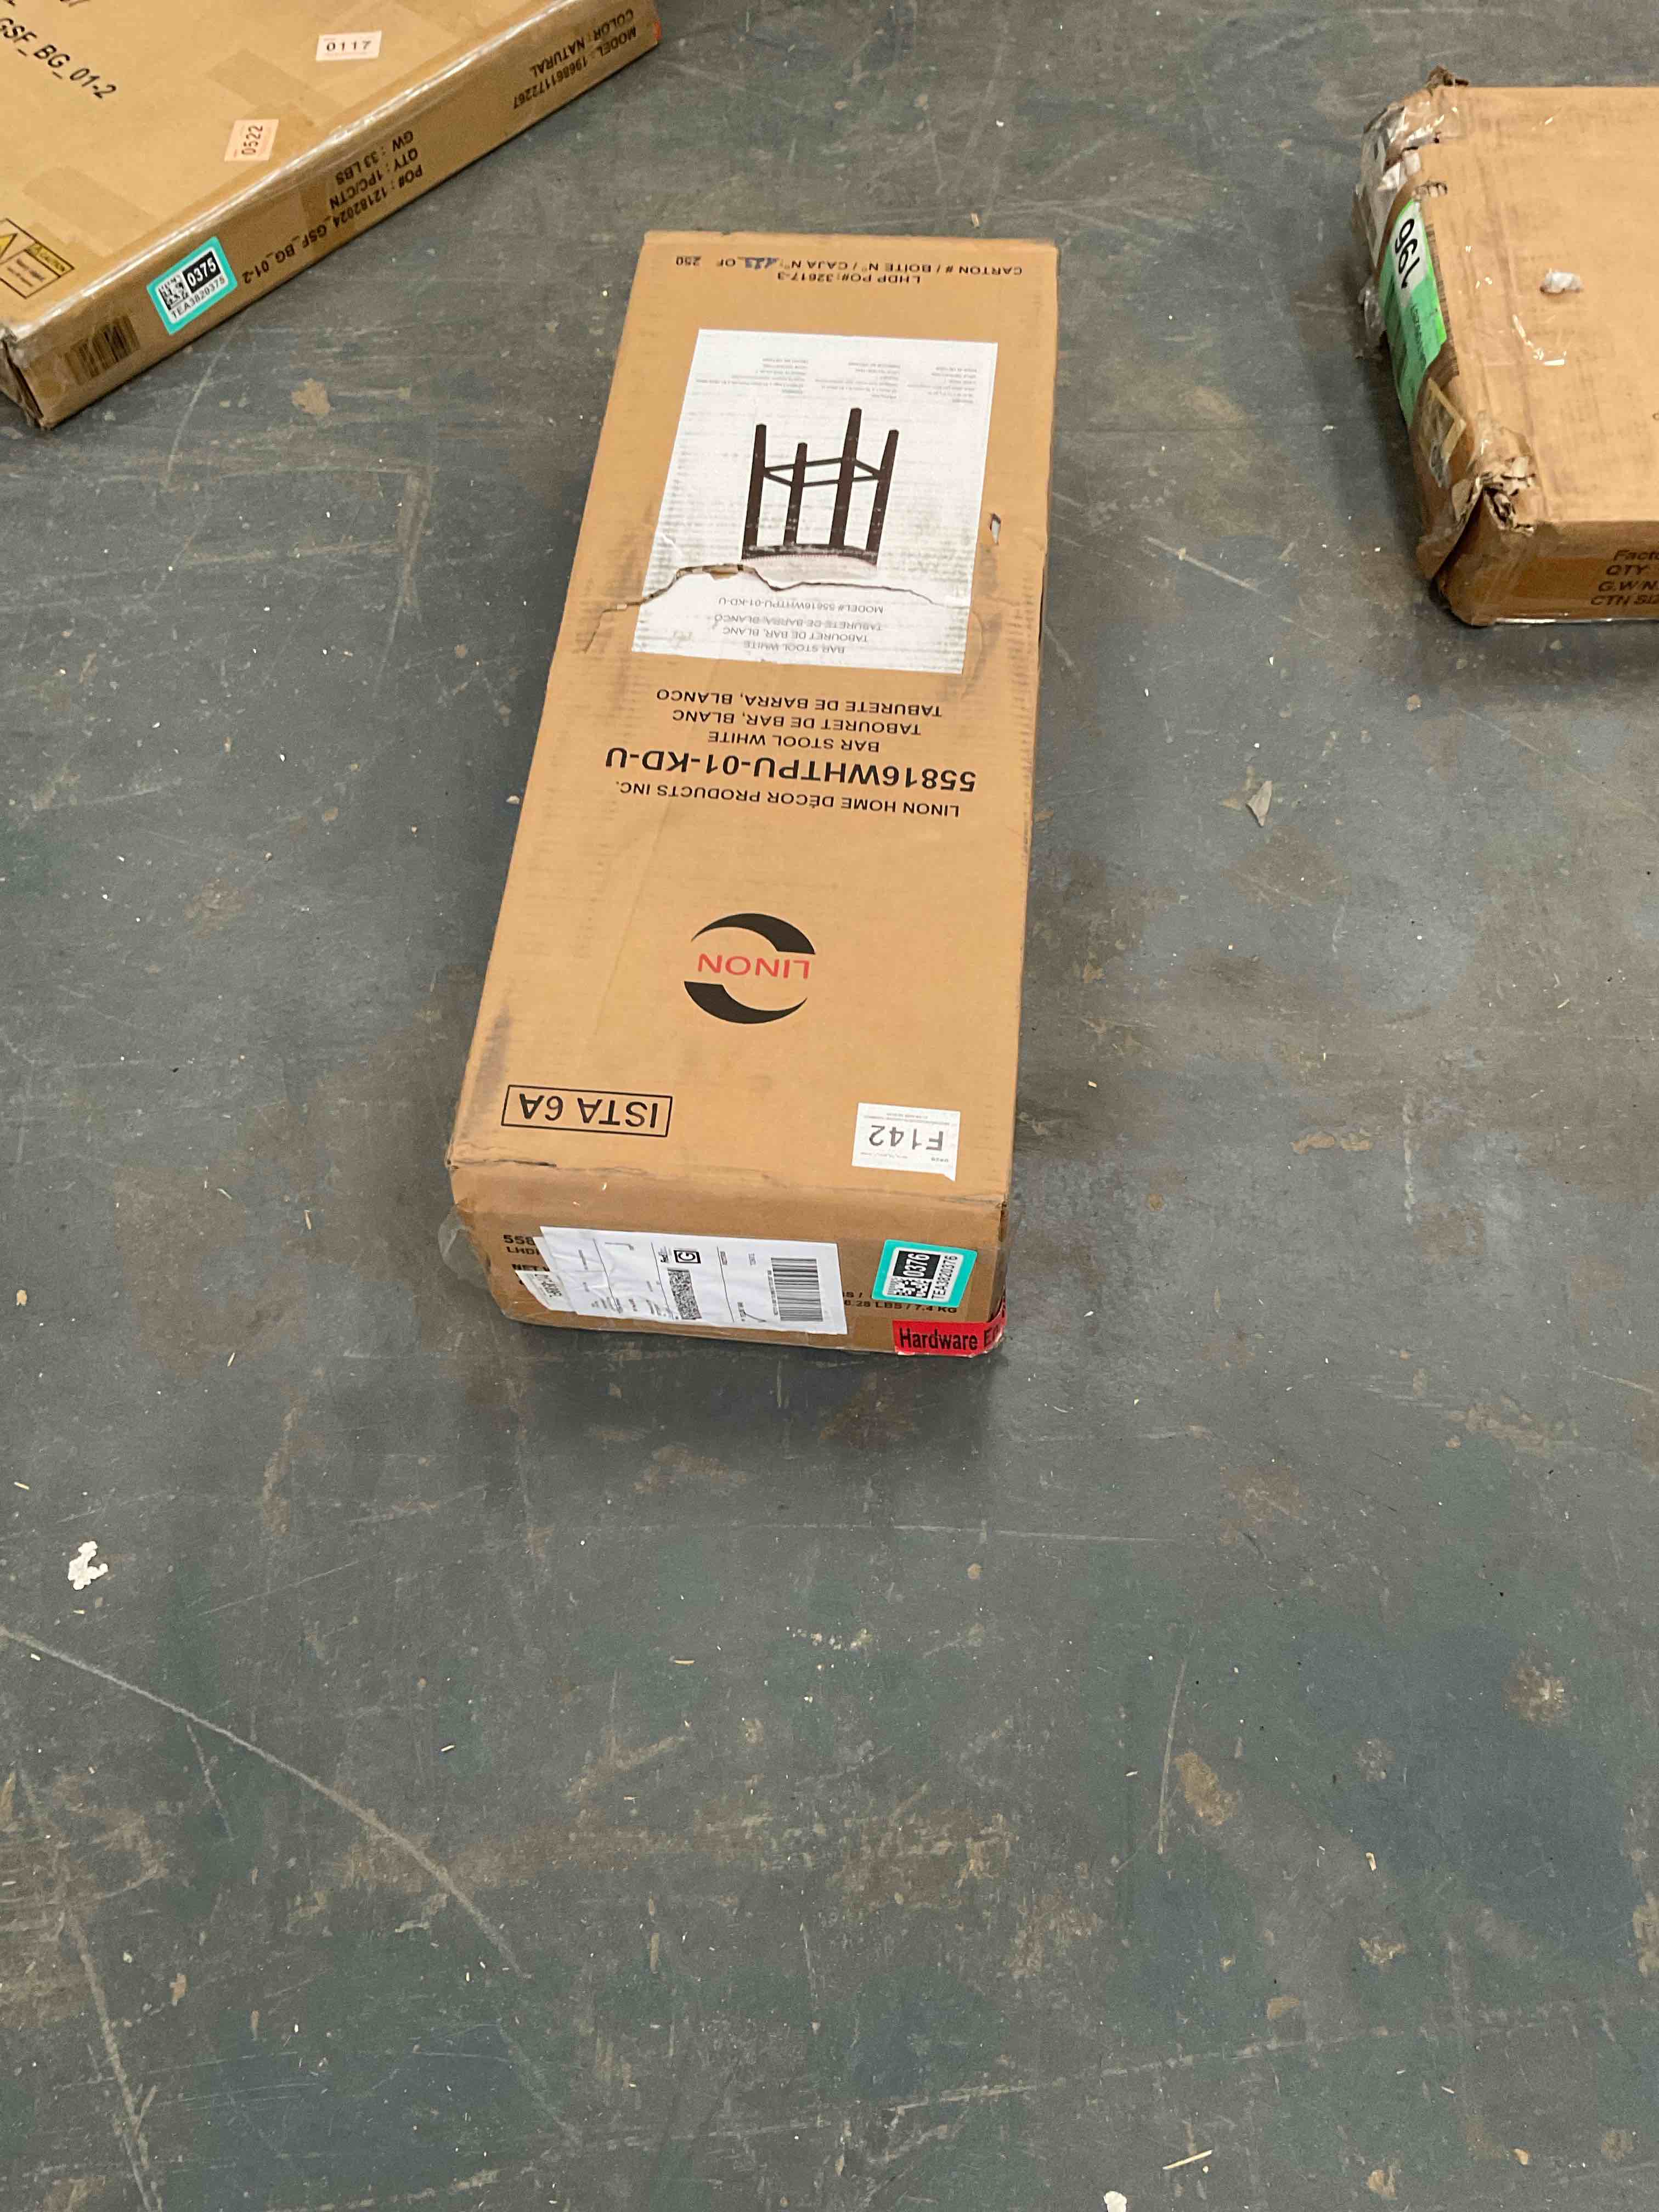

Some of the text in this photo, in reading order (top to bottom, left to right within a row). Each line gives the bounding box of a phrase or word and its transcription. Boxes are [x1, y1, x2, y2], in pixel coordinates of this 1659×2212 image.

[594, 9, 634, 41] COLOR
[326, 40, 371, 52] 0117
[597, 26, 636, 57] MODEL
[529, 37, 585, 77] NATURAL
[241, 125, 263, 155] 0522
[392, 131, 414, 151] GW
[394, 148, 419, 168] QTY
[335, 161, 362, 185] LBS
[330, 170, 383, 209] 1PC/CTN
[675, 255, 700, 266] 250
[806, 260, 847, 269] CAJA
[958, 265, 1022, 275] CARTON
[187, 258, 216, 286] 0375
[877, 273, 920, 284] LHDP
[1606, 565, 1649, 575] QTY
[837, 603, 883, 614] MODEL#
[1591, 594, 1630, 606] CTN
[721, 626, 759, 636] BLANC
[805, 618, 821, 628] DE
[824, 620, 882, 630] TABURETE
[791, 630, 805, 639] DE
[808, 630, 867, 642] TABOURET
[743, 639, 844, 653] BAR STOOL WHITE
[655, 688, 941, 717] TABURETE DE BARRA, BLANCO
[671, 708, 921, 736] TABOURET DE BAR, BLANC
[707, 730, 879, 752] BAR STOOL WHITE
[604, 746, 976, 793] 55816WHTPU-01-KD-U
[614, 780, 959, 817] LINON HOME DÉCOR PRODUCTS INC.
[696, 953, 810, 979] LINON
[516, 1093, 658, 1128] ISTA 6A
[868, 1124, 943, 1151] F142
[903, 1253, 930, 1277] 0376
[899, 1328, 979, 1351] Hardware
